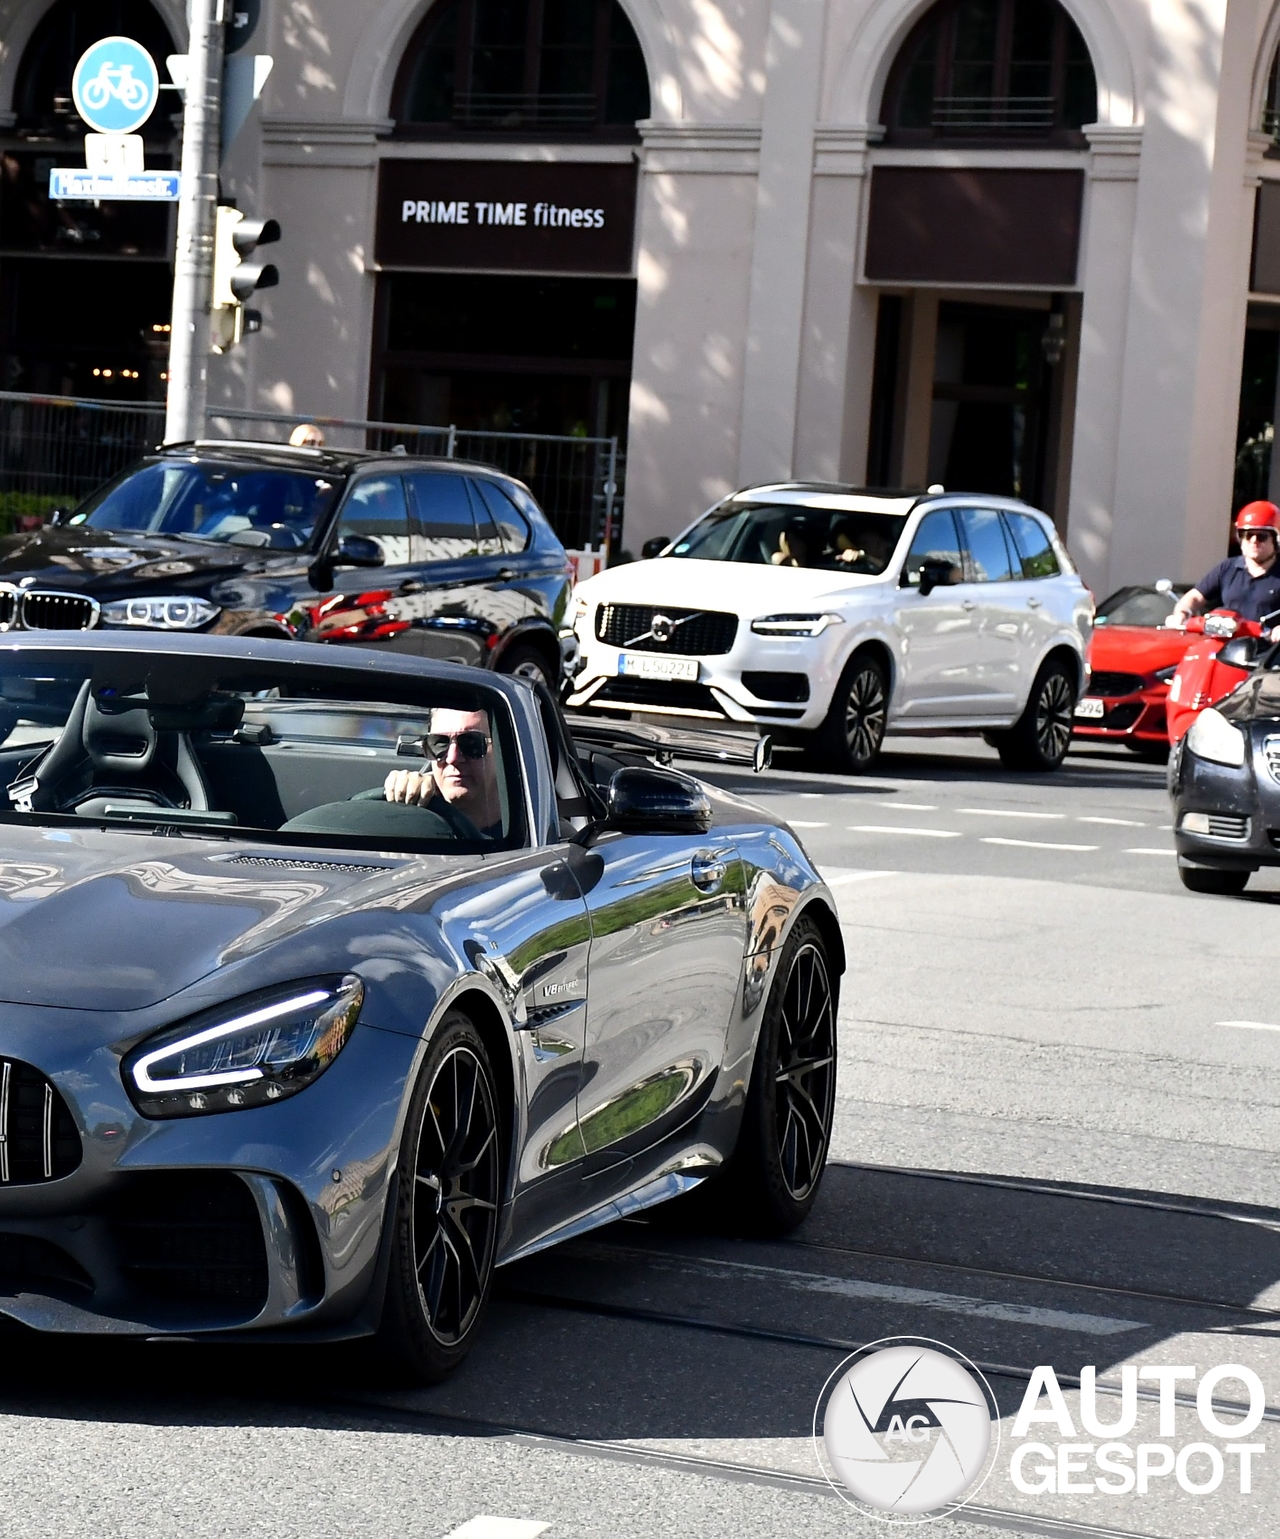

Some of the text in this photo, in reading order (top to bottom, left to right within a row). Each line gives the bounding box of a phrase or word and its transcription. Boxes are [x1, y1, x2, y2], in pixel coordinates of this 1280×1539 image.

[402, 200, 605, 228] PRIME TIME fitness
